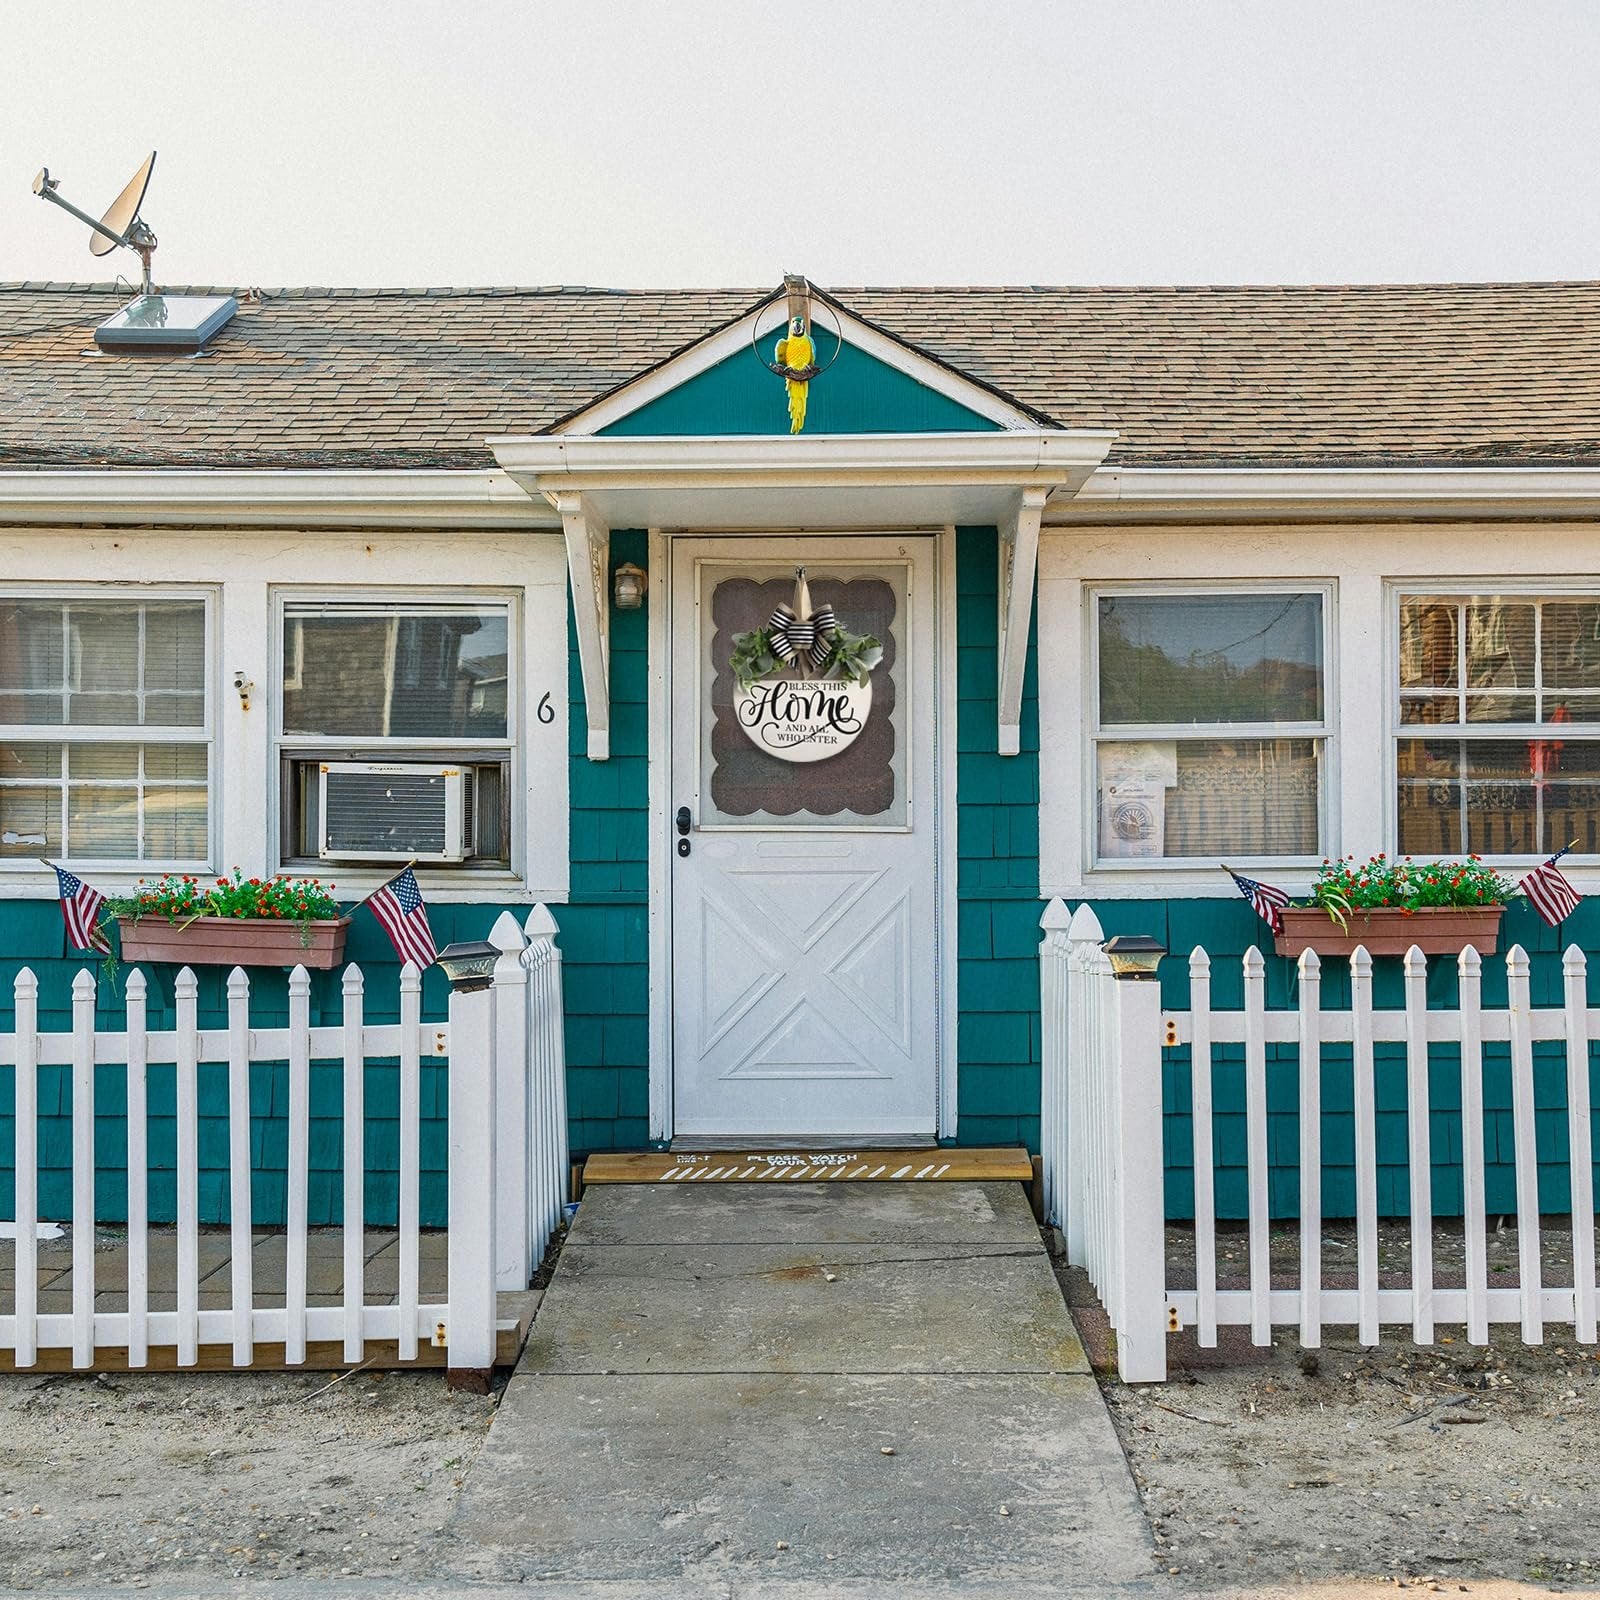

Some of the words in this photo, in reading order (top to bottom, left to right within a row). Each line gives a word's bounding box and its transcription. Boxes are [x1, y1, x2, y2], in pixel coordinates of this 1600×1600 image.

[789, 682, 819, 691] BLESS
[821, 682, 847, 691] THIS
[537, 691, 555, 724] 6
[739, 681, 861, 734] Home
[785, 724, 807, 733] AND
[809, 725, 829, 734] ALL
[777, 733, 801, 743] WHO
[803, 734, 838, 744] ENTER
